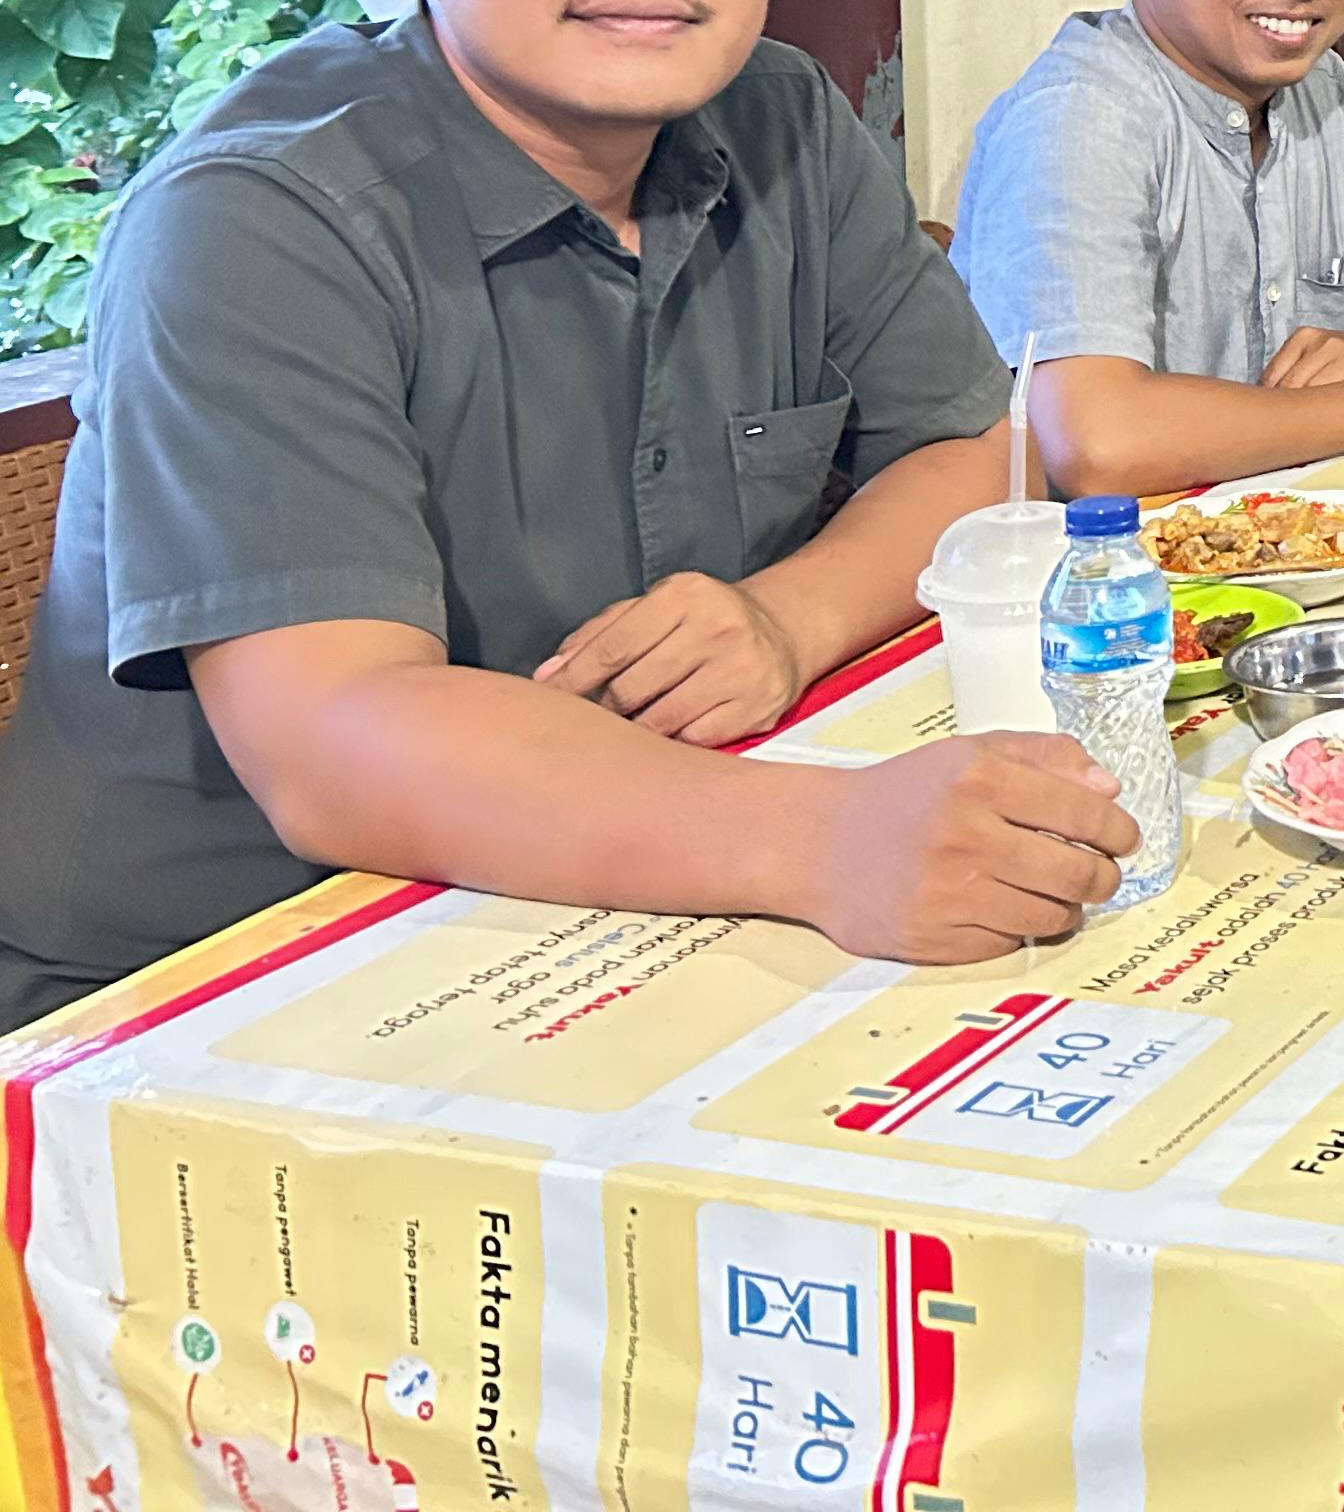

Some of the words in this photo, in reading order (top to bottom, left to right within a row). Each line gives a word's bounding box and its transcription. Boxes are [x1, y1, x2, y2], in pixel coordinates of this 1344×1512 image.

[554, 922, 648, 968] Celsius
[1132, 938, 1226, 996] Yakult
[1216, 891, 1287, 938] adalah
[1276, 871, 1311, 891] 40
[470, 948, 545, 986] tetap
[490, 970, 552, 1004] agar
[559, 959, 621, 998] pada
[1081, 952, 1150, 993] Masa
[1182, 966, 1241, 1005] sejak
[1232, 921, 1297, 968] proses
[492, 994, 559, 1032] suhu
[523, 983, 646, 1044] Yakult
[1037, 1032, 1112, 1071] 40
[1101, 1039, 1177, 1080] Hari
[176, 1162, 197, 1264] Bersertifikat
[273, 1164, 288, 1214] Tanpa
[275, 1216, 297, 1297] pengawet
[403, 1219, 420, 1270] Tanpa
[479, 1208, 514, 1330] Fakta
[186, 1266, 200, 1311] Halal
[405, 1271, 420, 1346] pewarna
[475, 1340, 520, 1504] menarik
[726, 1374, 774, 1475] Hari
[793, 1391, 856, 1485] 40
